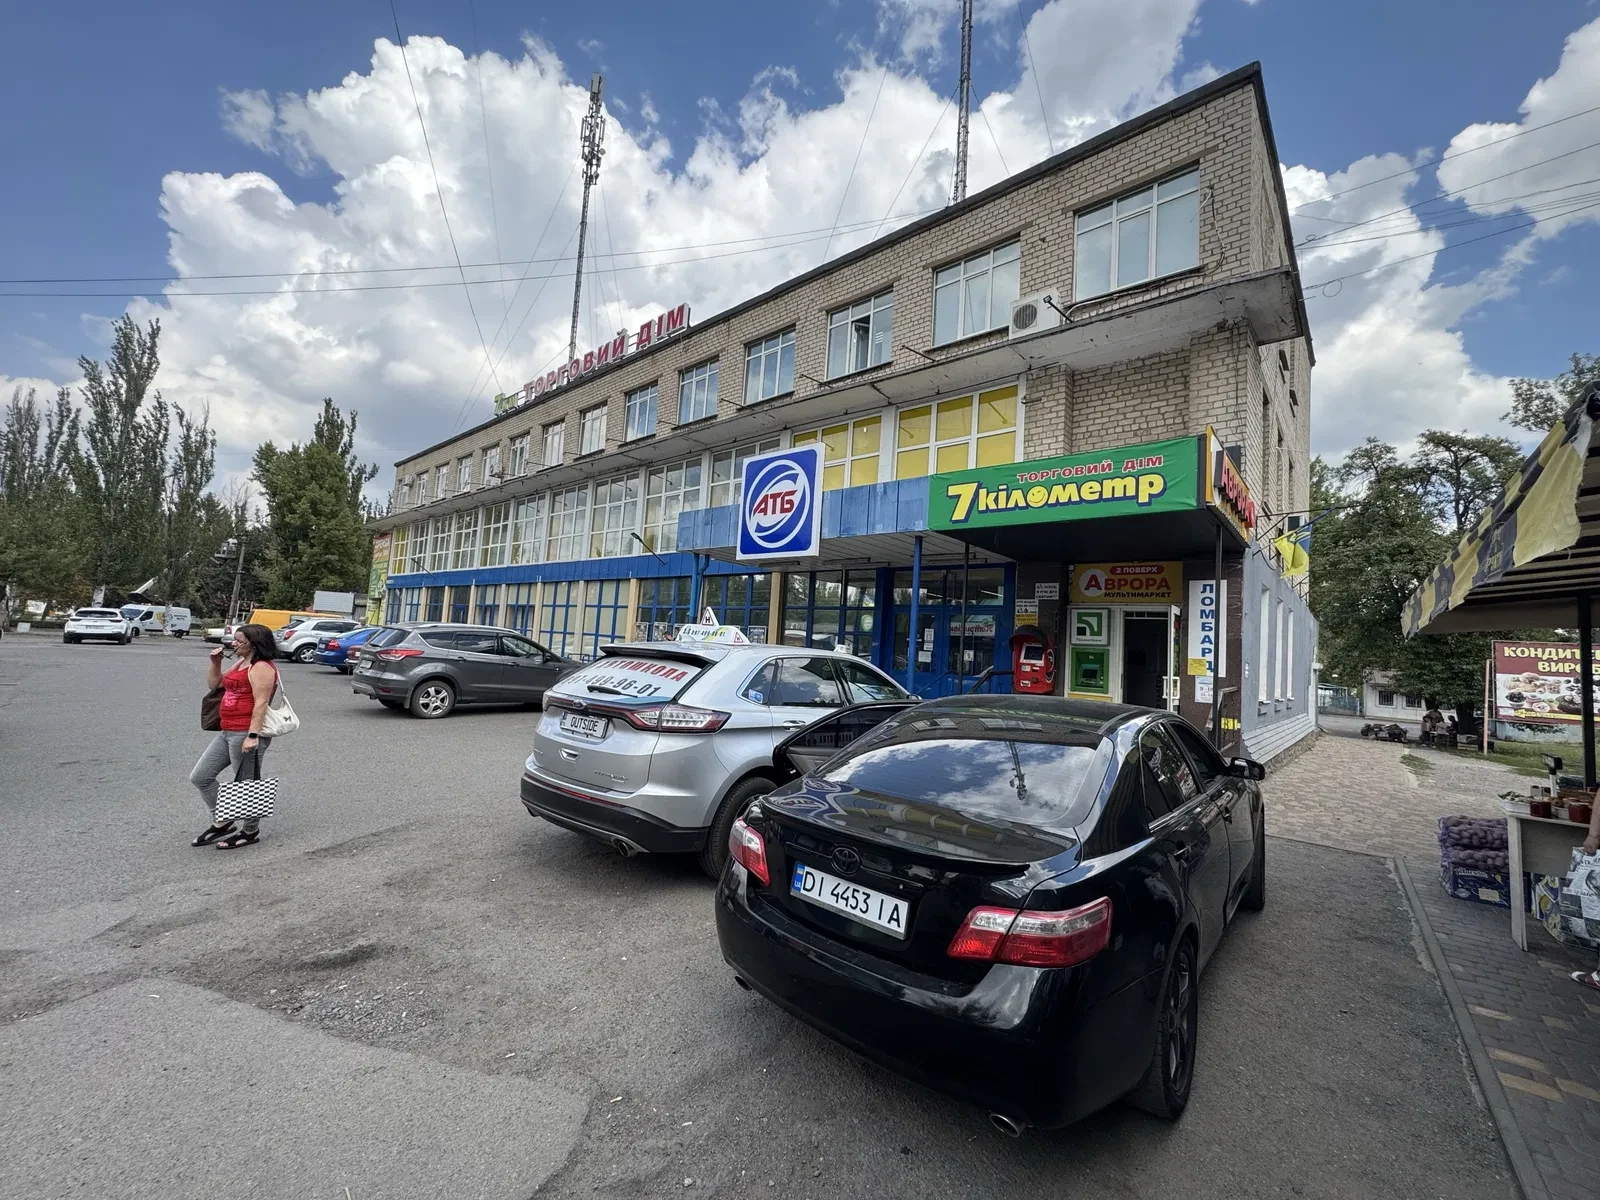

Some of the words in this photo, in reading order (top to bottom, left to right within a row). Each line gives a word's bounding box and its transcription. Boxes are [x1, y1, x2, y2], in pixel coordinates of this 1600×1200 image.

[523, 329, 628, 401] ТОРГОВИЙ
[635, 303, 689, 350] ДІМ
[1017, 460, 1113, 483] ТОРГОВИЙ
[1122, 455, 1164, 473] ДІМ
[753, 490, 798, 517] АТБ
[1504, 647, 1600, 660] КОНДИТ
[570, 716, 600, 732] OUTSIDE
[802, 871, 824, 897] DI
[830, 882, 871, 914] 4453
[878, 898, 901, 928] IA
